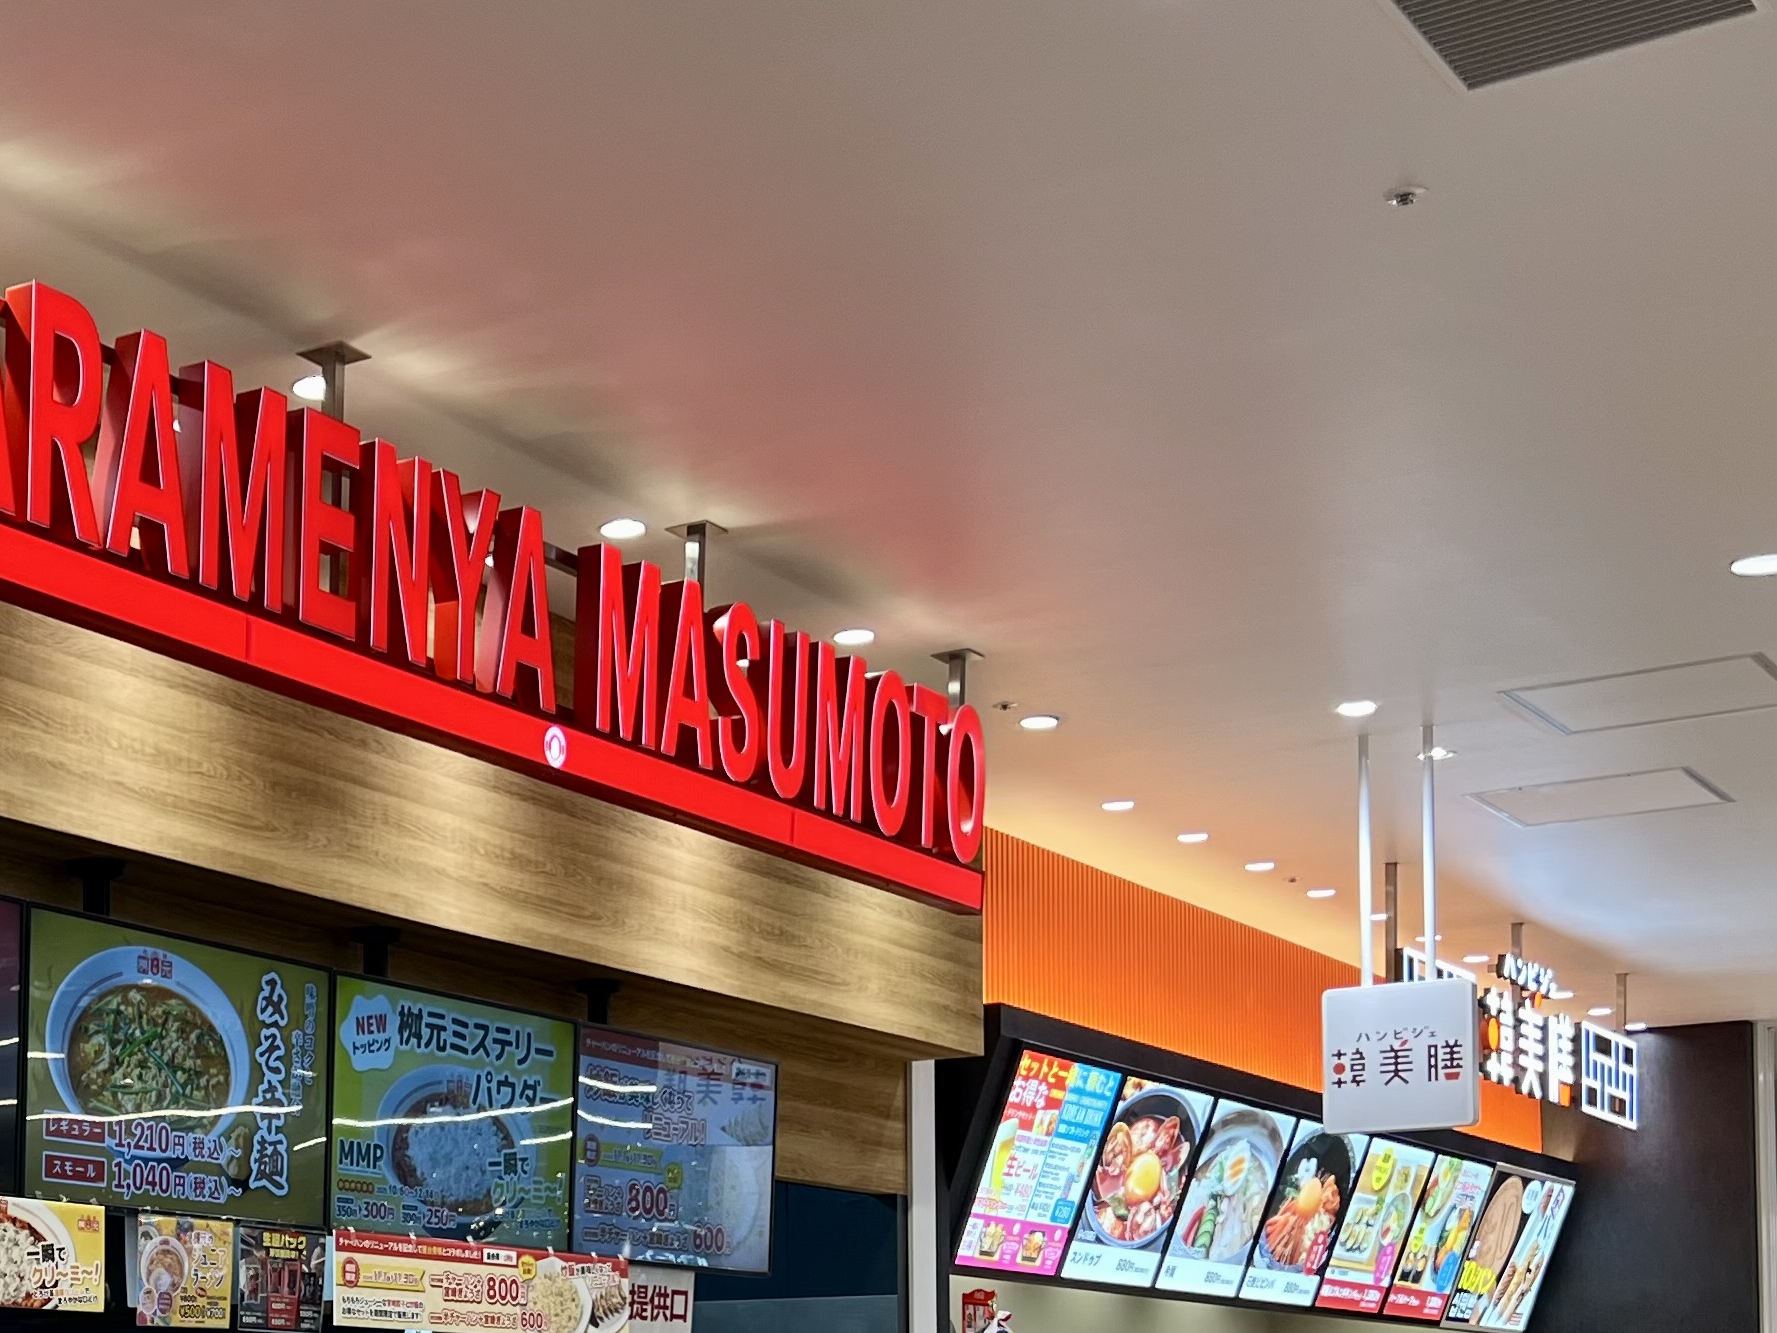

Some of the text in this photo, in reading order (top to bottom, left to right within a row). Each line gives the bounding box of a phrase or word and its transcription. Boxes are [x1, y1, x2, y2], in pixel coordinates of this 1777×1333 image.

[578, 542, 986, 864] MASUMOTO
[355, 1013, 388, 1037] NEW
[397, 1003, 555, 1067] 桝元ミステリー
[1356, 1025, 1438, 1043] ハンビジェ
[351, 1037, 391, 1056] トッピング
[1331, 1039, 1464, 1089] 韓美膳
[251, 972, 288, 1196] みそ辛麺
[471, 1070, 560, 1113] パウダー
[47, 1119, 104, 1139] レギュラー
[51, 1159, 97, 1179] スモール
[338, 1138, 384, 1170] MMP
[26, 1243, 68, 1265] 一瞬で
[627, 1284, 689, 1324] 提供口
